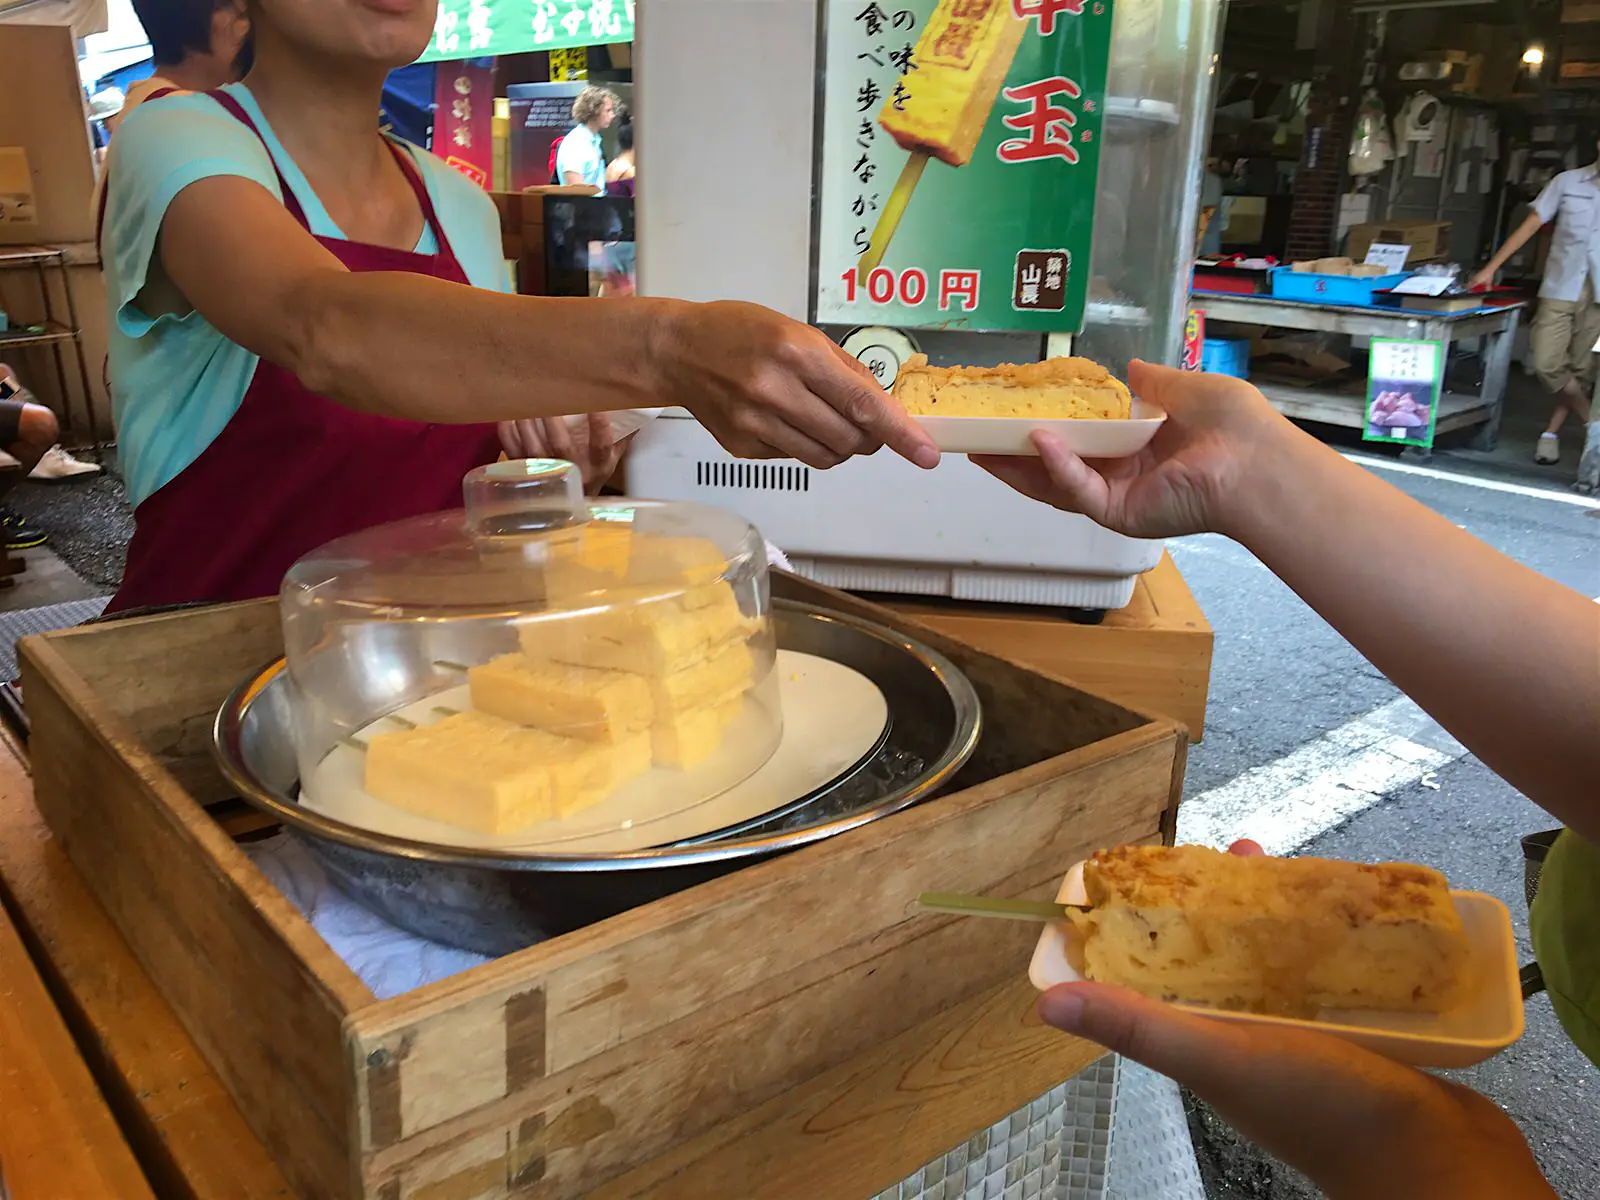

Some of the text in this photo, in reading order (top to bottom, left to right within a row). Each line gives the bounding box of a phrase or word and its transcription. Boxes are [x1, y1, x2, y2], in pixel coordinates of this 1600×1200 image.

[852, 2, 889, 255] 食べ歩きながら
[887, 9, 919, 111] の味を
